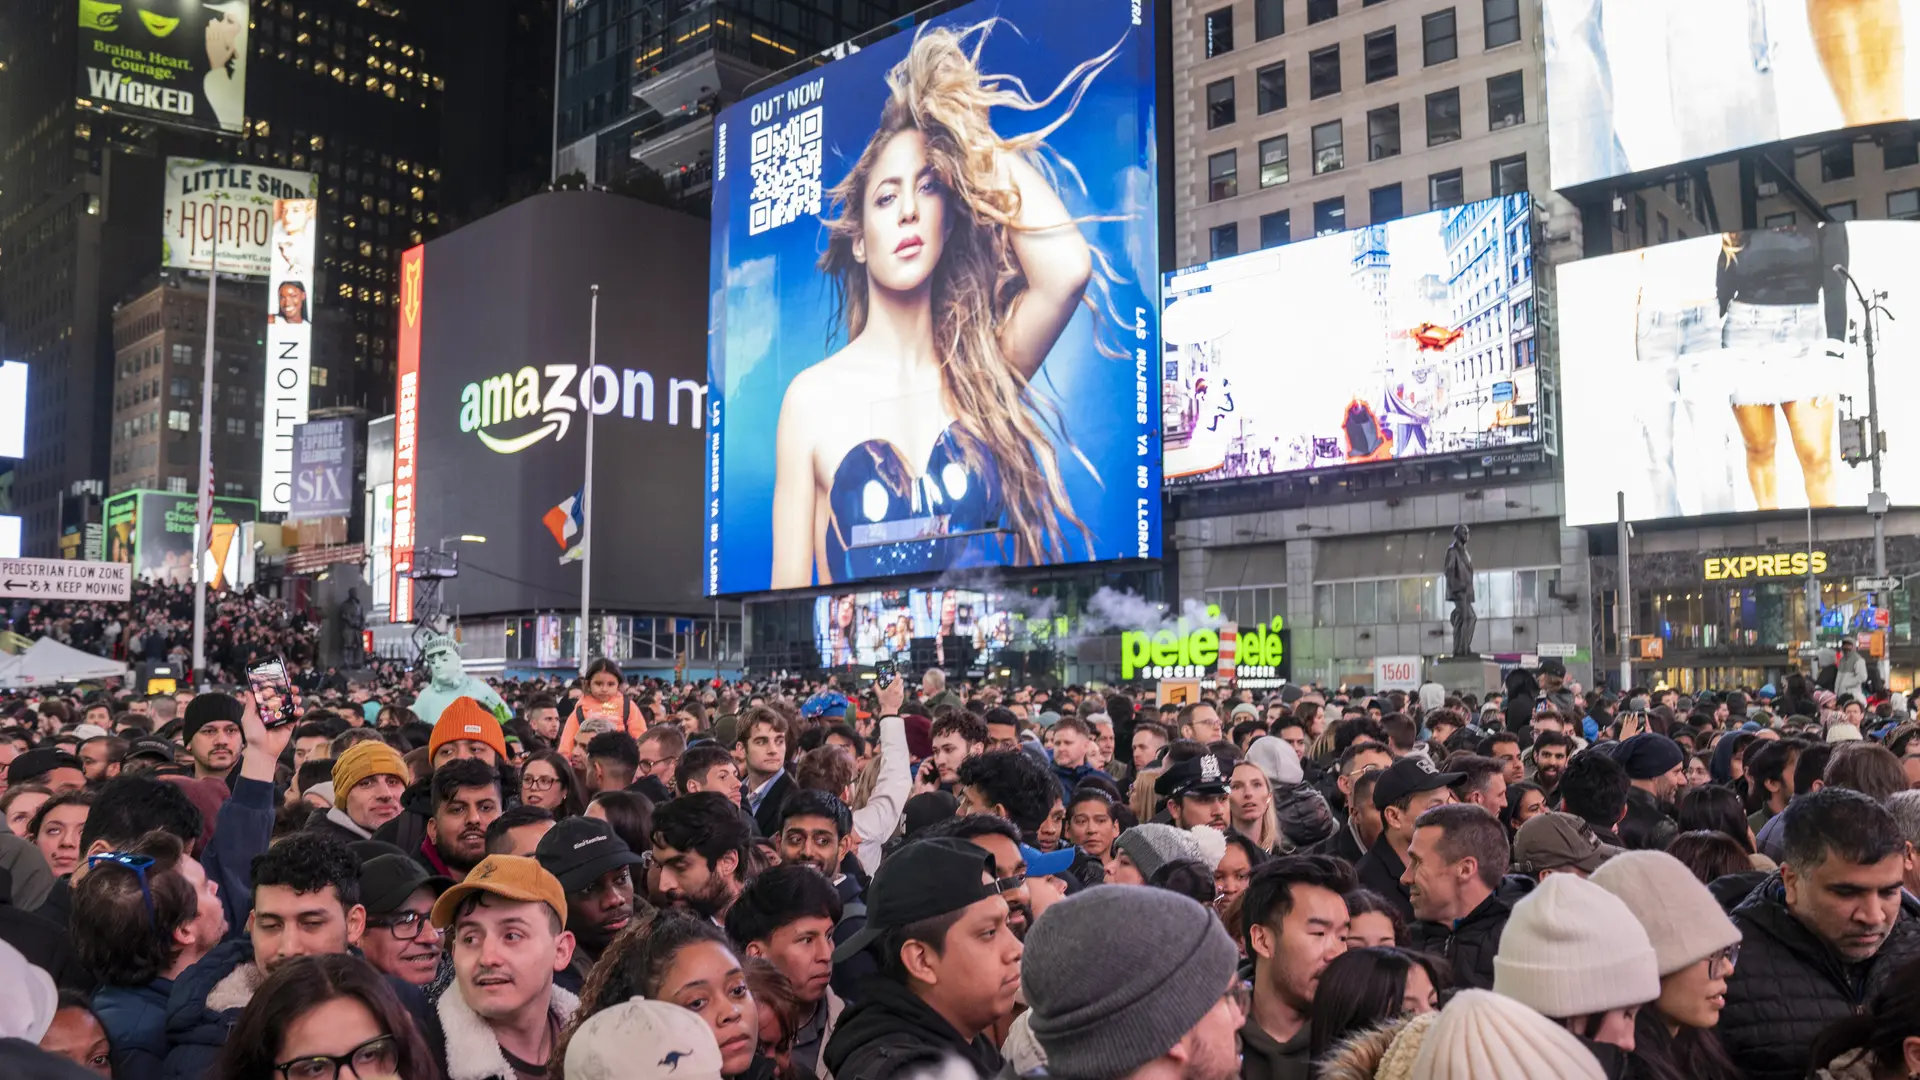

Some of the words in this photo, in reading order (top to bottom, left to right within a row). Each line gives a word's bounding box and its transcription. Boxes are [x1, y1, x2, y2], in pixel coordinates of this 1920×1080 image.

[93, 40, 146, 61] Brains.
[149, 51, 193, 71] Heart.
[111, 57, 176, 80] Courage.
[751, 93, 785, 126] OUT
[787, 77, 824, 111] NOW
[718, 122, 727, 182] SHAKIRA
[182, 168, 252, 195] LITTLE
[1135, 306, 1147, 340] LAS
[460, 364, 654, 433] amazon
[1136, 347, 1148, 425] MUJERES
[398, 371, 417, 480] HERSHEY'S
[712, 400, 721, 427] LAS
[1137, 434, 1148, 457] YA
[711, 432, 720, 493] MUJERES
[1137, 464, 1149, 489] NO
[394, 481, 415, 549] STORE
[711, 498, 719, 518] YA
[710, 523, 719, 543] NO
[2, 562, 65, 577] PEDESTRIAN
[67, 565, 96, 579] FLOW
[99, 567, 124, 580] ZONE
[1703, 551, 1828, 580] EXPRESS
[56, 581, 82, 593] KEEP
[85, 582, 125, 596] MOVING
[1141, 665, 1206, 680] SOCCER
[1236, 665, 1276, 677] SOCCER
[1382, 663, 1410, 681] 1560
